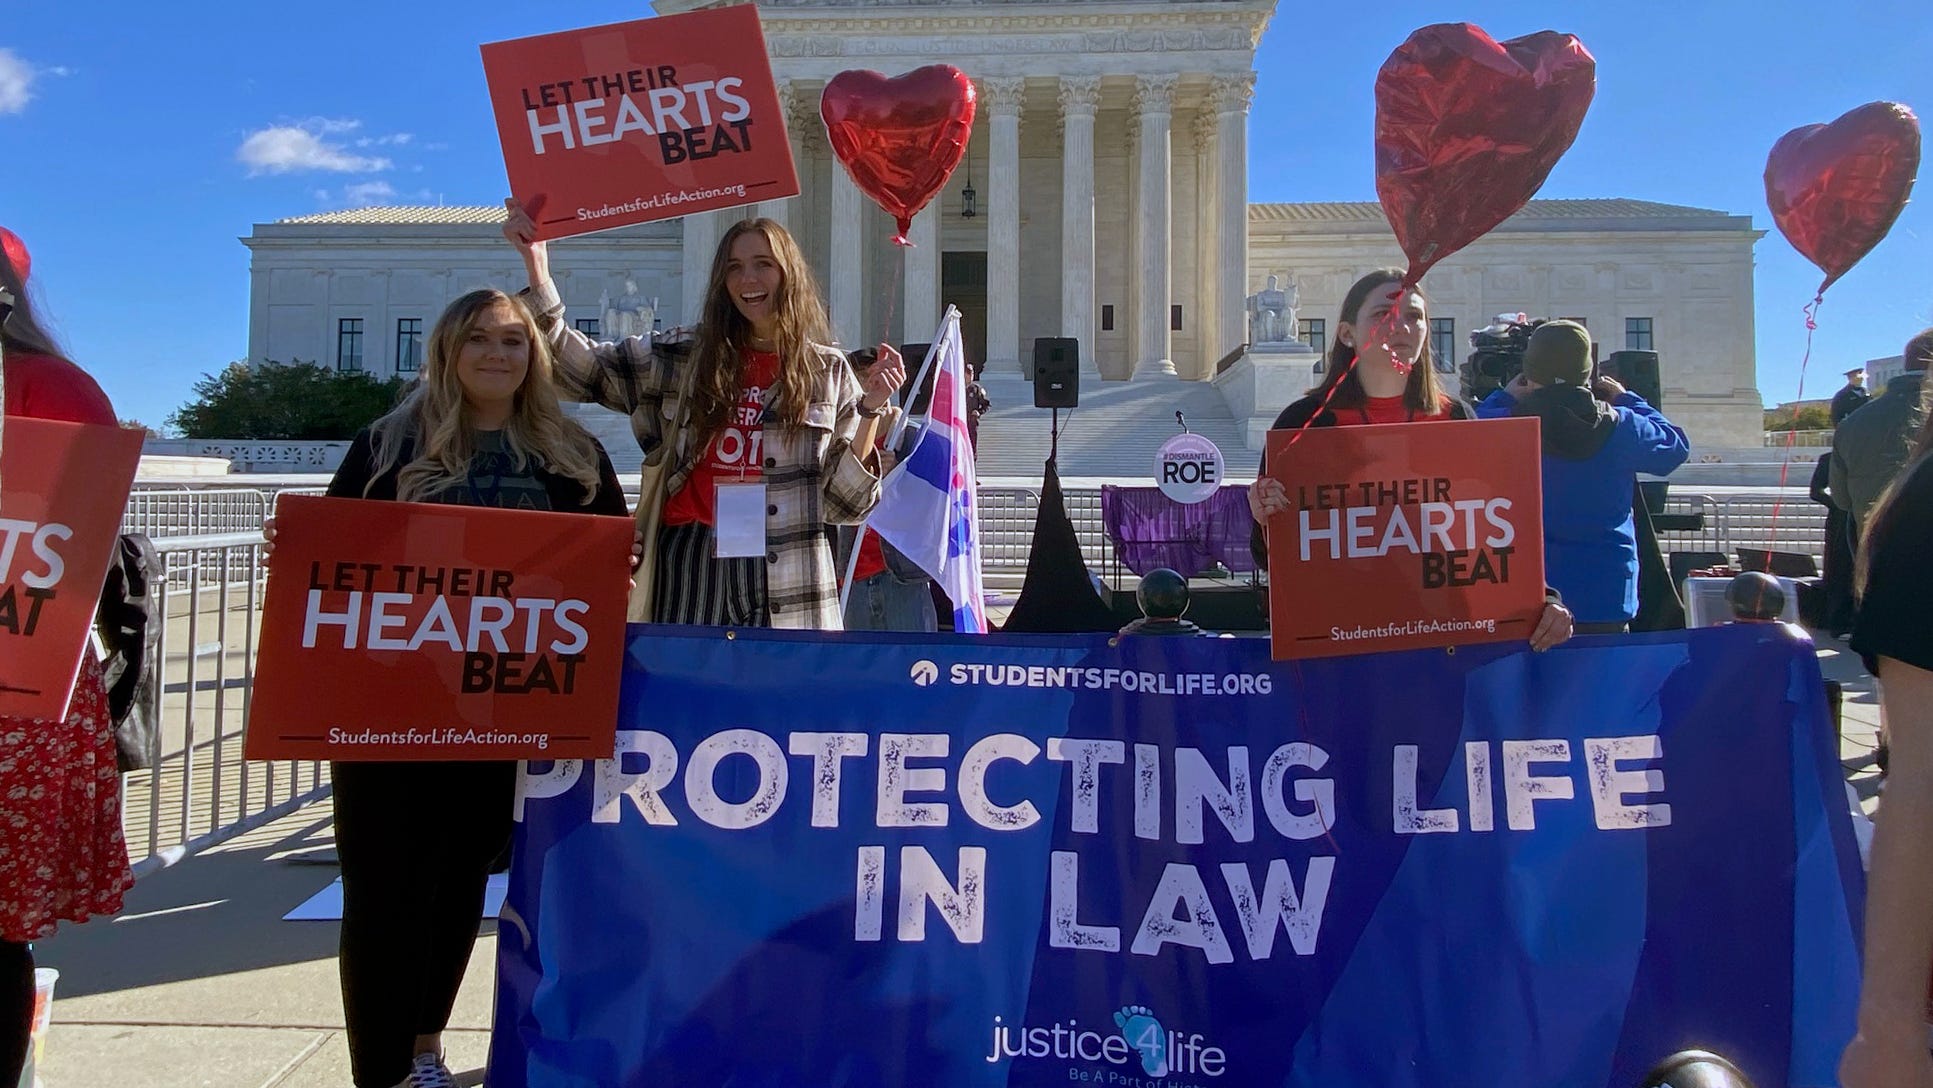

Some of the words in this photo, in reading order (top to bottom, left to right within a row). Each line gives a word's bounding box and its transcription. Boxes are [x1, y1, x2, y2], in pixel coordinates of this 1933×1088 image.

[522, 80, 576, 110] LET
[582, 65, 679, 100] THEIR
[526, 77, 751, 155] HEARTS
[659, 119, 753, 165] BEAT
[577, 183, 747, 222] StudentsforLifeAction.org
[1163, 452, 1215, 461] #DISMANTLE
[1163, 461, 1215, 484] ROE
[1299, 484, 1350, 512] LET
[1359, 477, 1451, 507] THEIR
[1299, 497, 1515, 561] HEARTS
[309, 561, 382, 592] LET
[393, 565, 514, 598] THEIR
[1422, 547, 1515, 589] BEAT
[302, 589, 590, 655] HEARTS
[1330, 617, 1496, 642] StudentsforLifeAction.org
[461, 652, 586, 695] BEAT
[950, 663, 1272, 695] STUDENTSFORLIFE.ORG
[328, 728, 548, 749] StudentsforLifeAction.org
[513, 729, 1336, 844] PROTECTING
[1393, 735, 1671, 832] LIFE
[855, 846, 986, 943] IN
[1049, 851, 1336, 964] LAW
[1069, 1068, 1089, 1081] Be
[1093, 1070, 1104, 1083] A
[1109, 1072, 1141, 1088] Part
